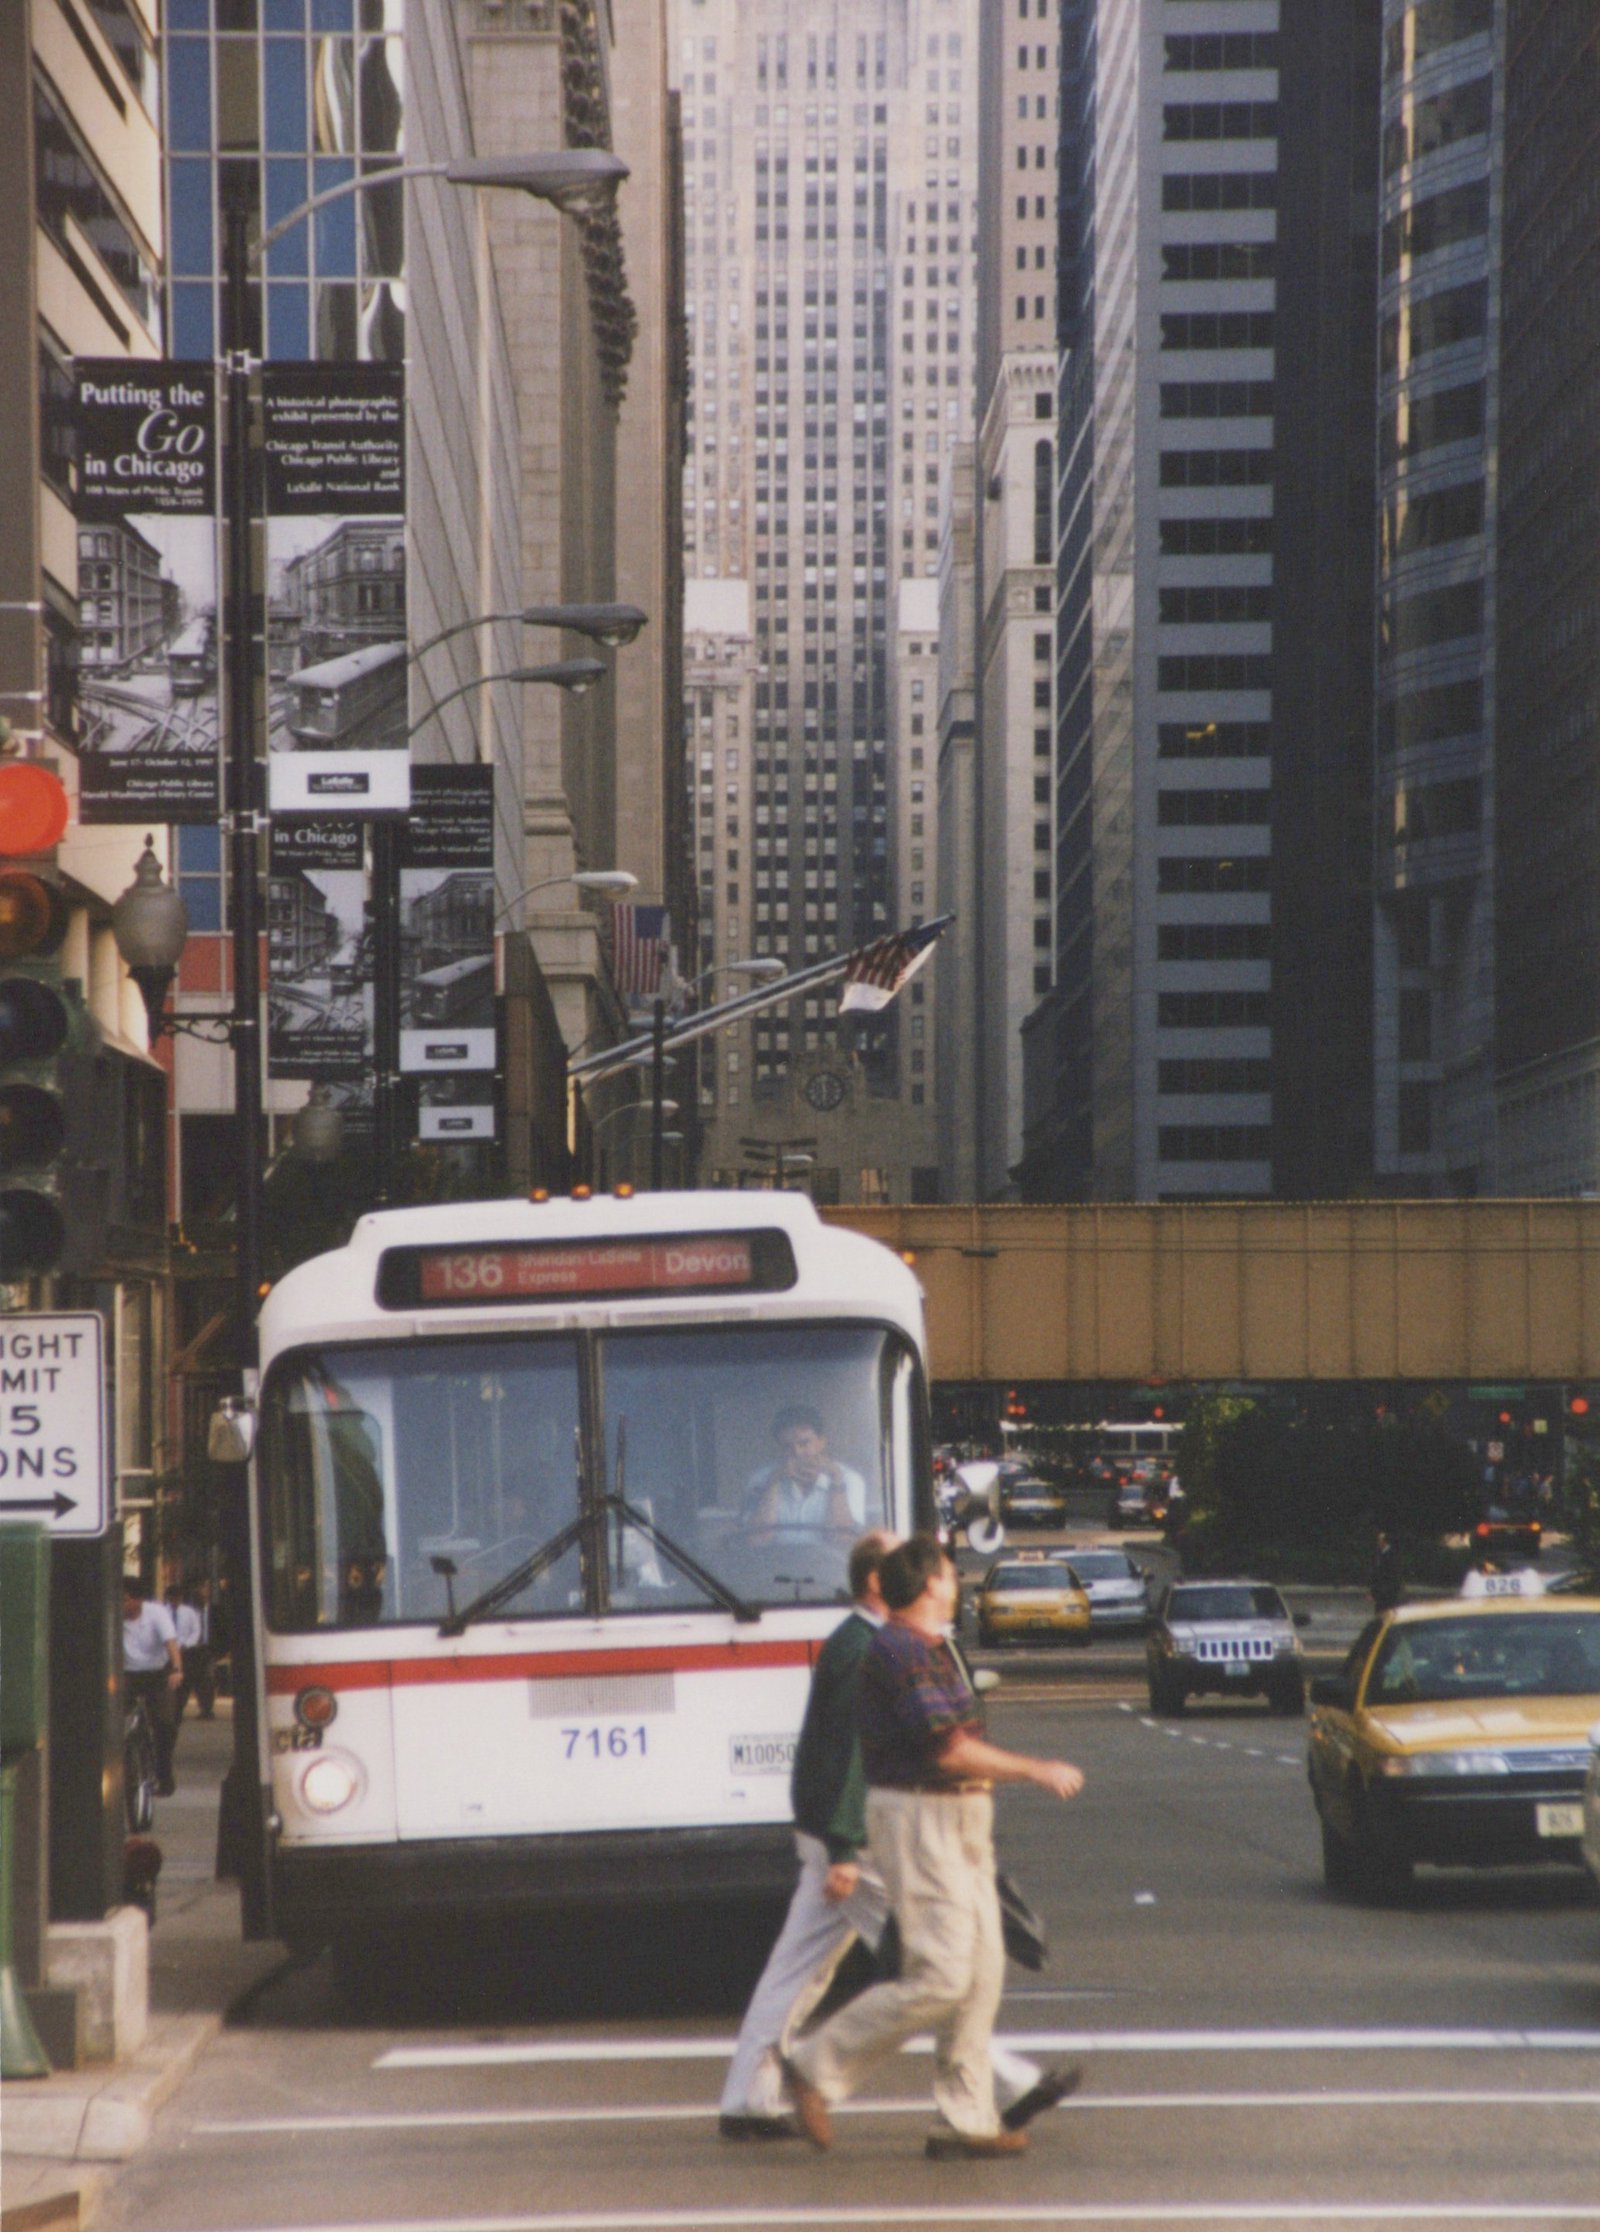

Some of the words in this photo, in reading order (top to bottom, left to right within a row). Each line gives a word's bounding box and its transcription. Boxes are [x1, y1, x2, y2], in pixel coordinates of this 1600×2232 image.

[81, 381, 163, 412] Putting
[169, 382, 205, 406] the
[266, 397, 275, 408] A
[276, 396, 326, 408] historical
[328, 396, 399, 411] photographic
[272, 410, 309, 422] exhibit
[310, 410, 363, 425] presented
[365, 410, 378, 424] by
[380, 410, 399, 422] the
[137, 409, 205, 455] Go
[265, 440, 309, 456] Chicago
[311, 440, 346, 451] Transit
[348, 439, 399, 454] Authority
[85, 453, 107, 476] in
[114, 453, 205, 484] Chicago
[281, 453, 324, 469] Chicago
[325, 453, 358, 466] Public
[361, 452, 400, 467] Library
[379, 467, 401, 480] and
[286, 481, 323, 494] LaSalle
[325, 481, 371, 492] National
[373, 481, 401, 492] Bank
[126, 779, 158, 790] Chicago
[160, 779, 185, 789] Public
[186, 779, 215, 790] Library
[274, 827, 290, 844] in
[294, 827, 358, 849] Chicago
[440, 1253, 503, 1290] 136
[664, 1249, 750, 1276] Devon
[517, 1269, 578, 1286] Express
[0, 1334, 83, 1360] IGHT
[1, 1367, 61, 1394] MIT
[10, 1405, 41, 1437] 5
[560, 1726, 647, 1760] 7161
[733, 1742, 798, 1766] M10050
